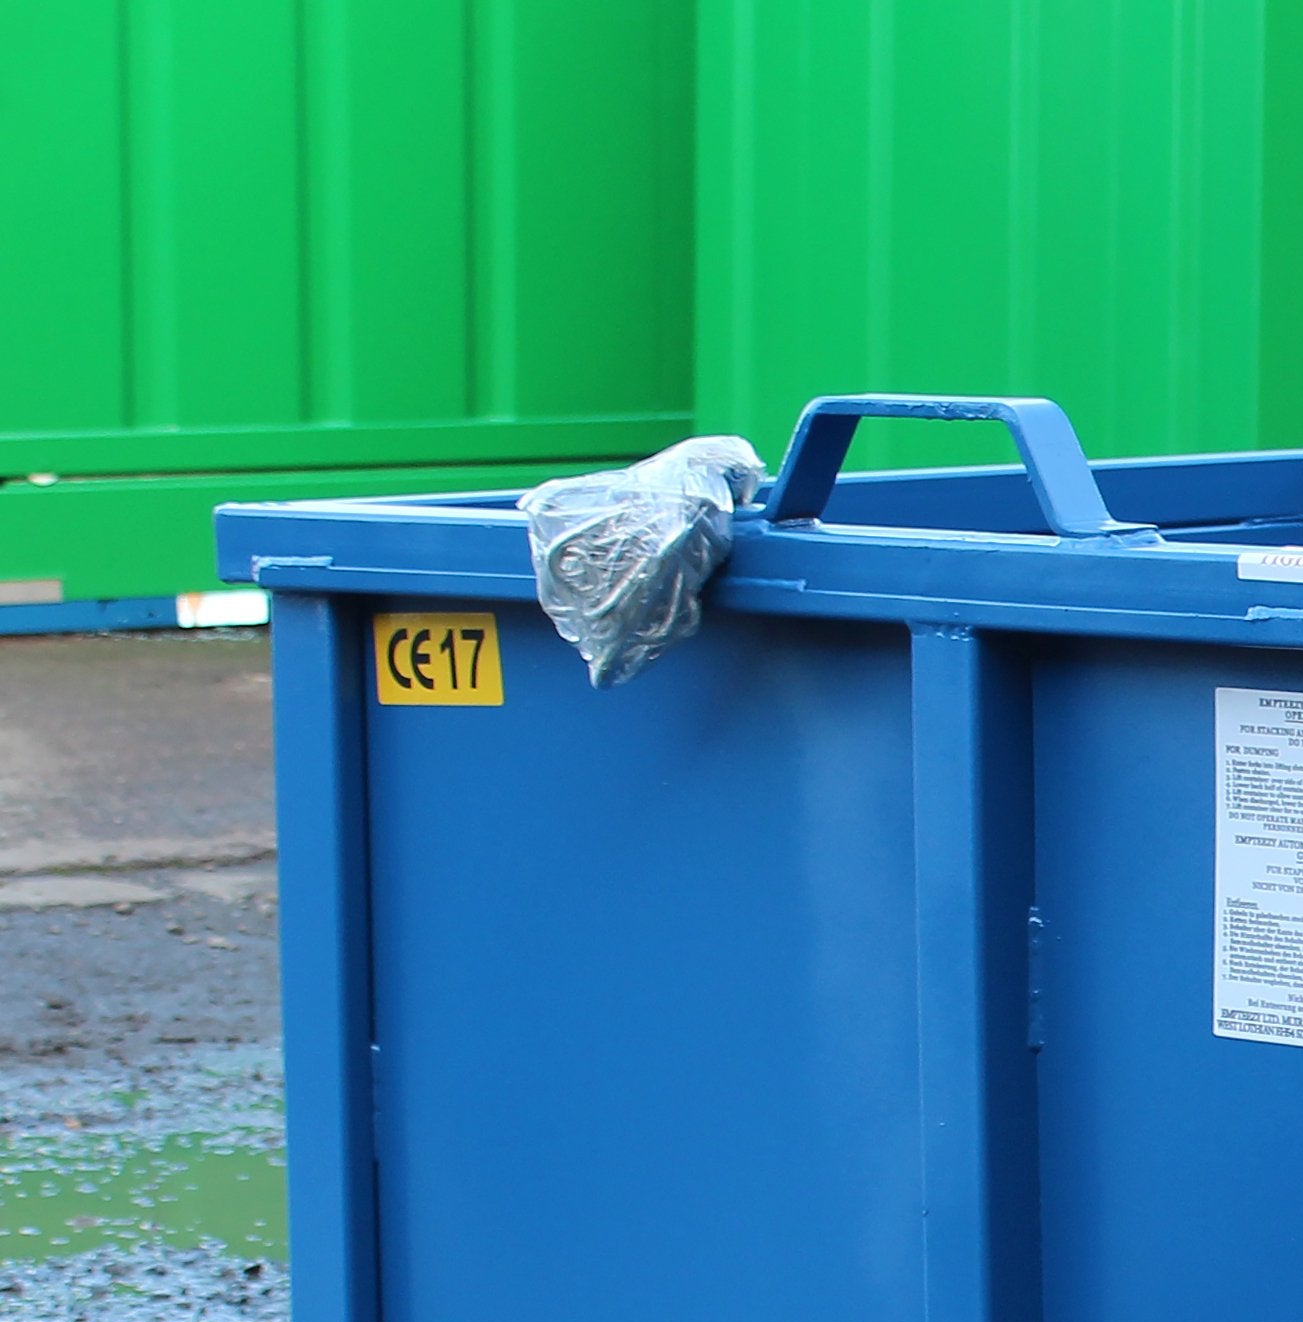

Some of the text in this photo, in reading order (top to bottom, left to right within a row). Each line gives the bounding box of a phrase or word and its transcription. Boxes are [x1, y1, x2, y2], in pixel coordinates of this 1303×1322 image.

[388, 628, 484, 690] CE 17
[1259, 698, 1303, 709] EMPTEEZY
